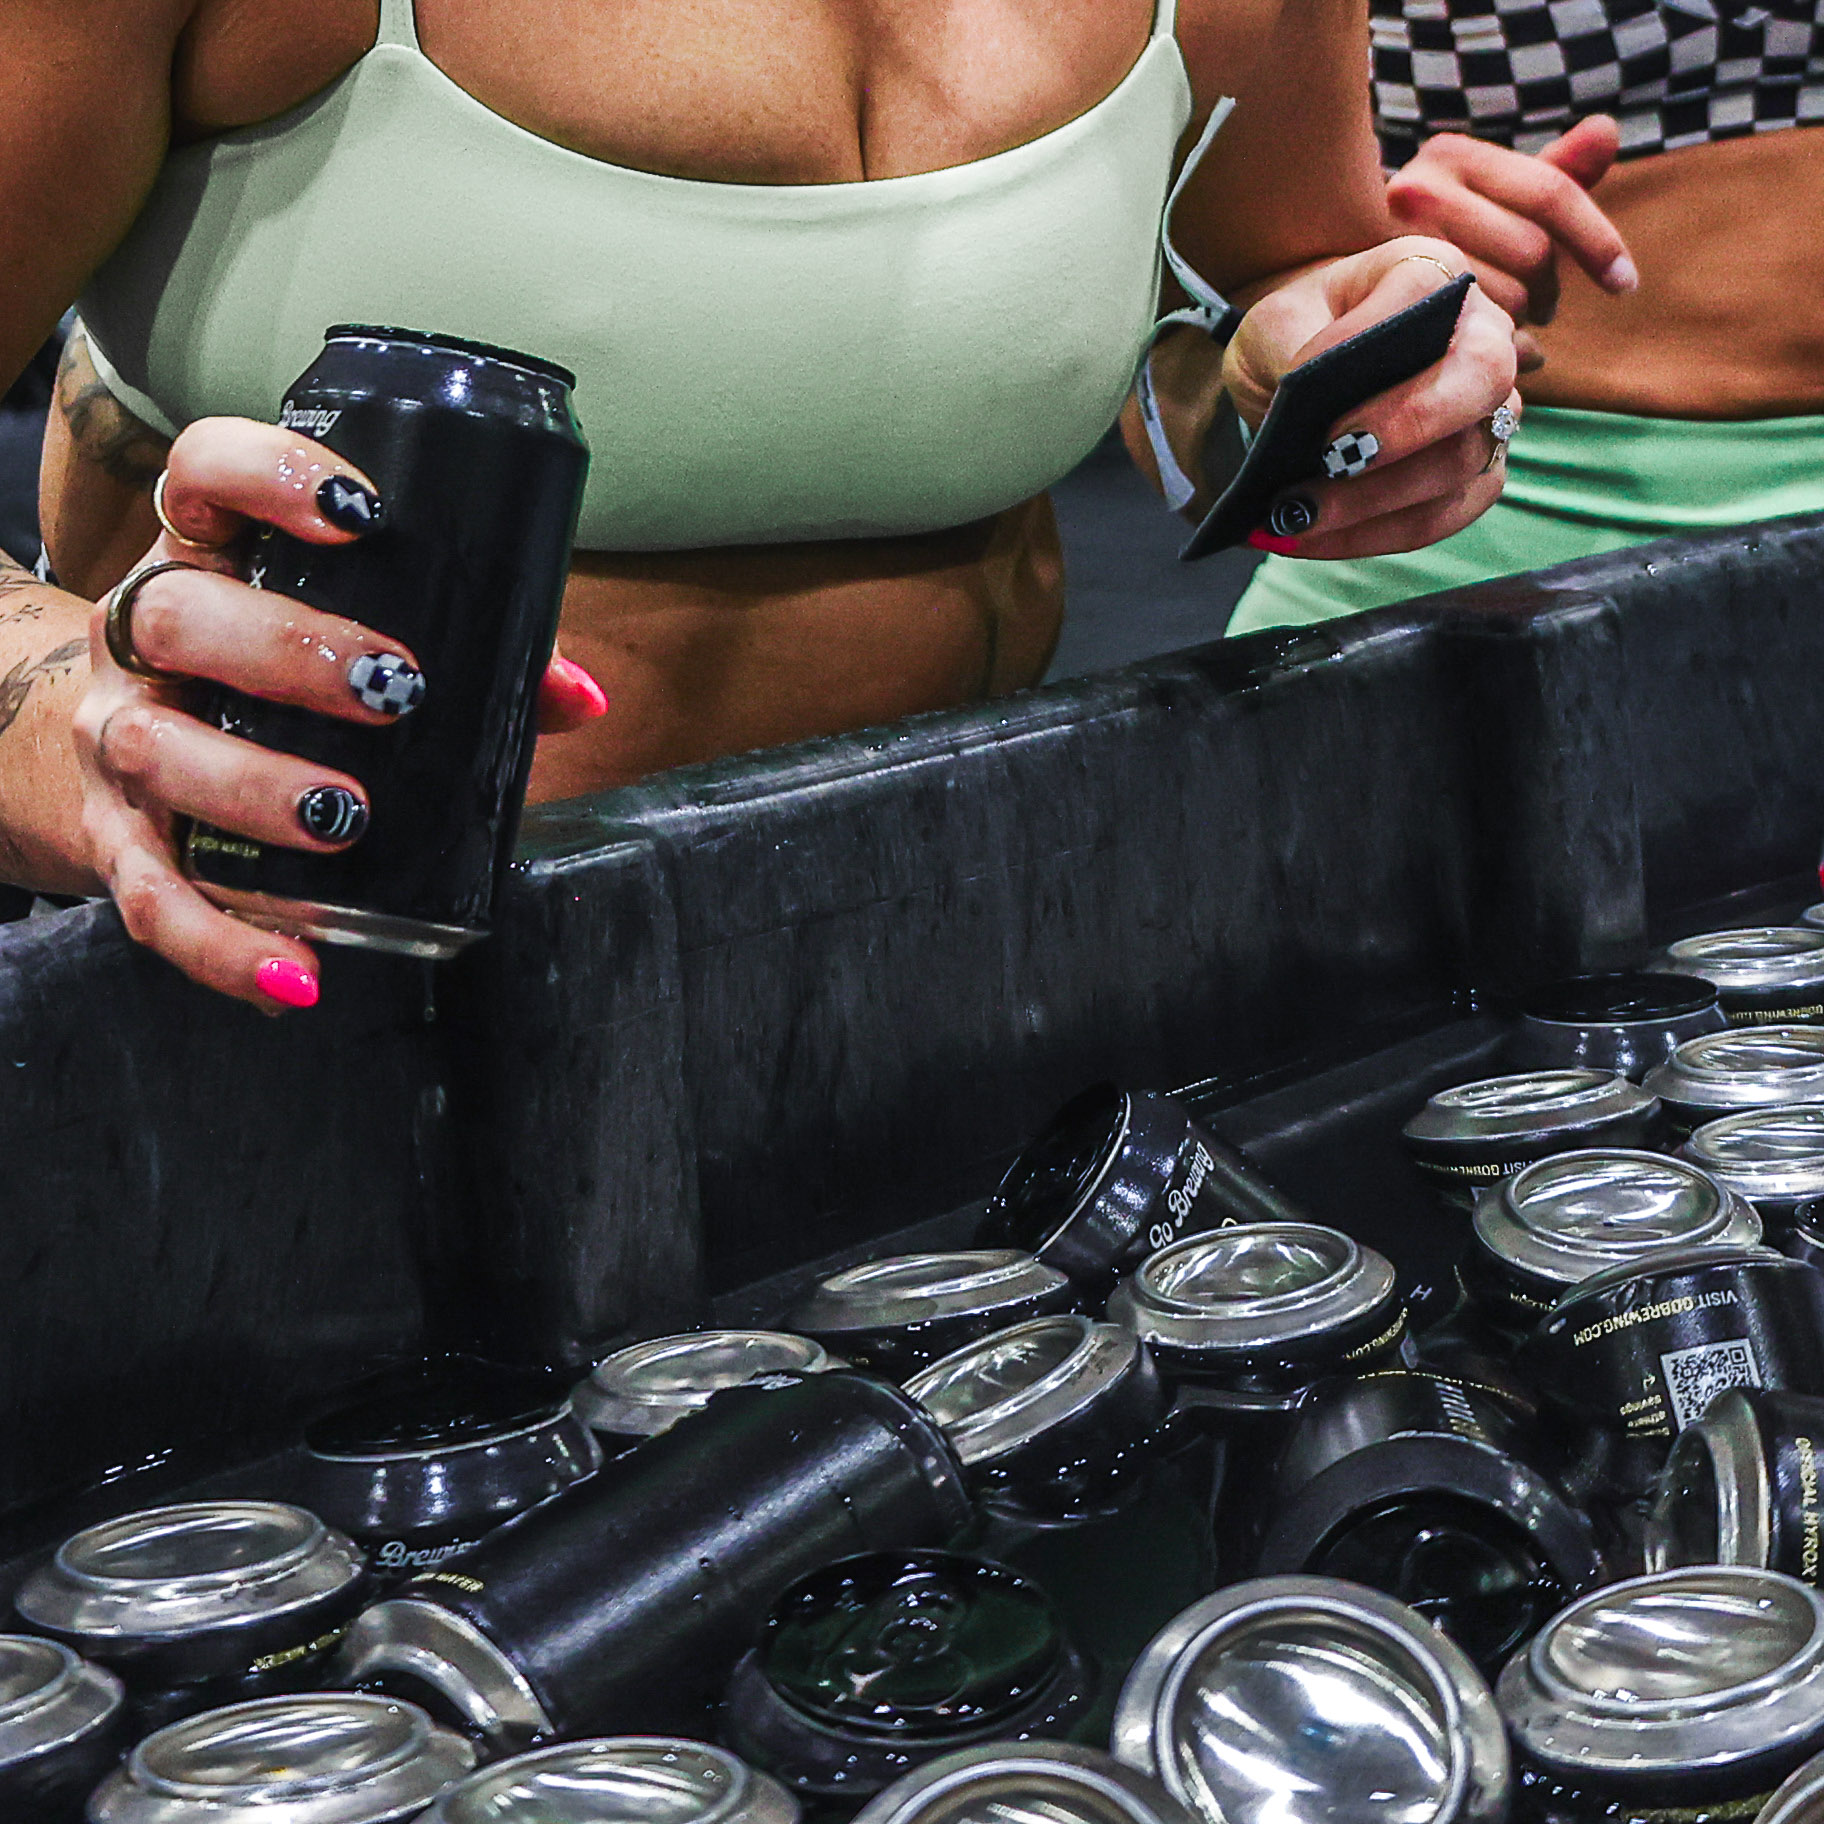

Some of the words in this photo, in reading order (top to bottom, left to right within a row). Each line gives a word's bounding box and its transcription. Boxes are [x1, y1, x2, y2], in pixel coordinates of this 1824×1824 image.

[1502, 1160, 1534, 1175] ISIT
[1149, 1221, 1174, 1249] Go
[1168, 1140, 1215, 1228] Brewing
[1698, 1289, 1738, 1309] VISIT
[1573, 1296, 1694, 1347] GOBREWING.COM
[375, 1537, 482, 1568] Brewin
